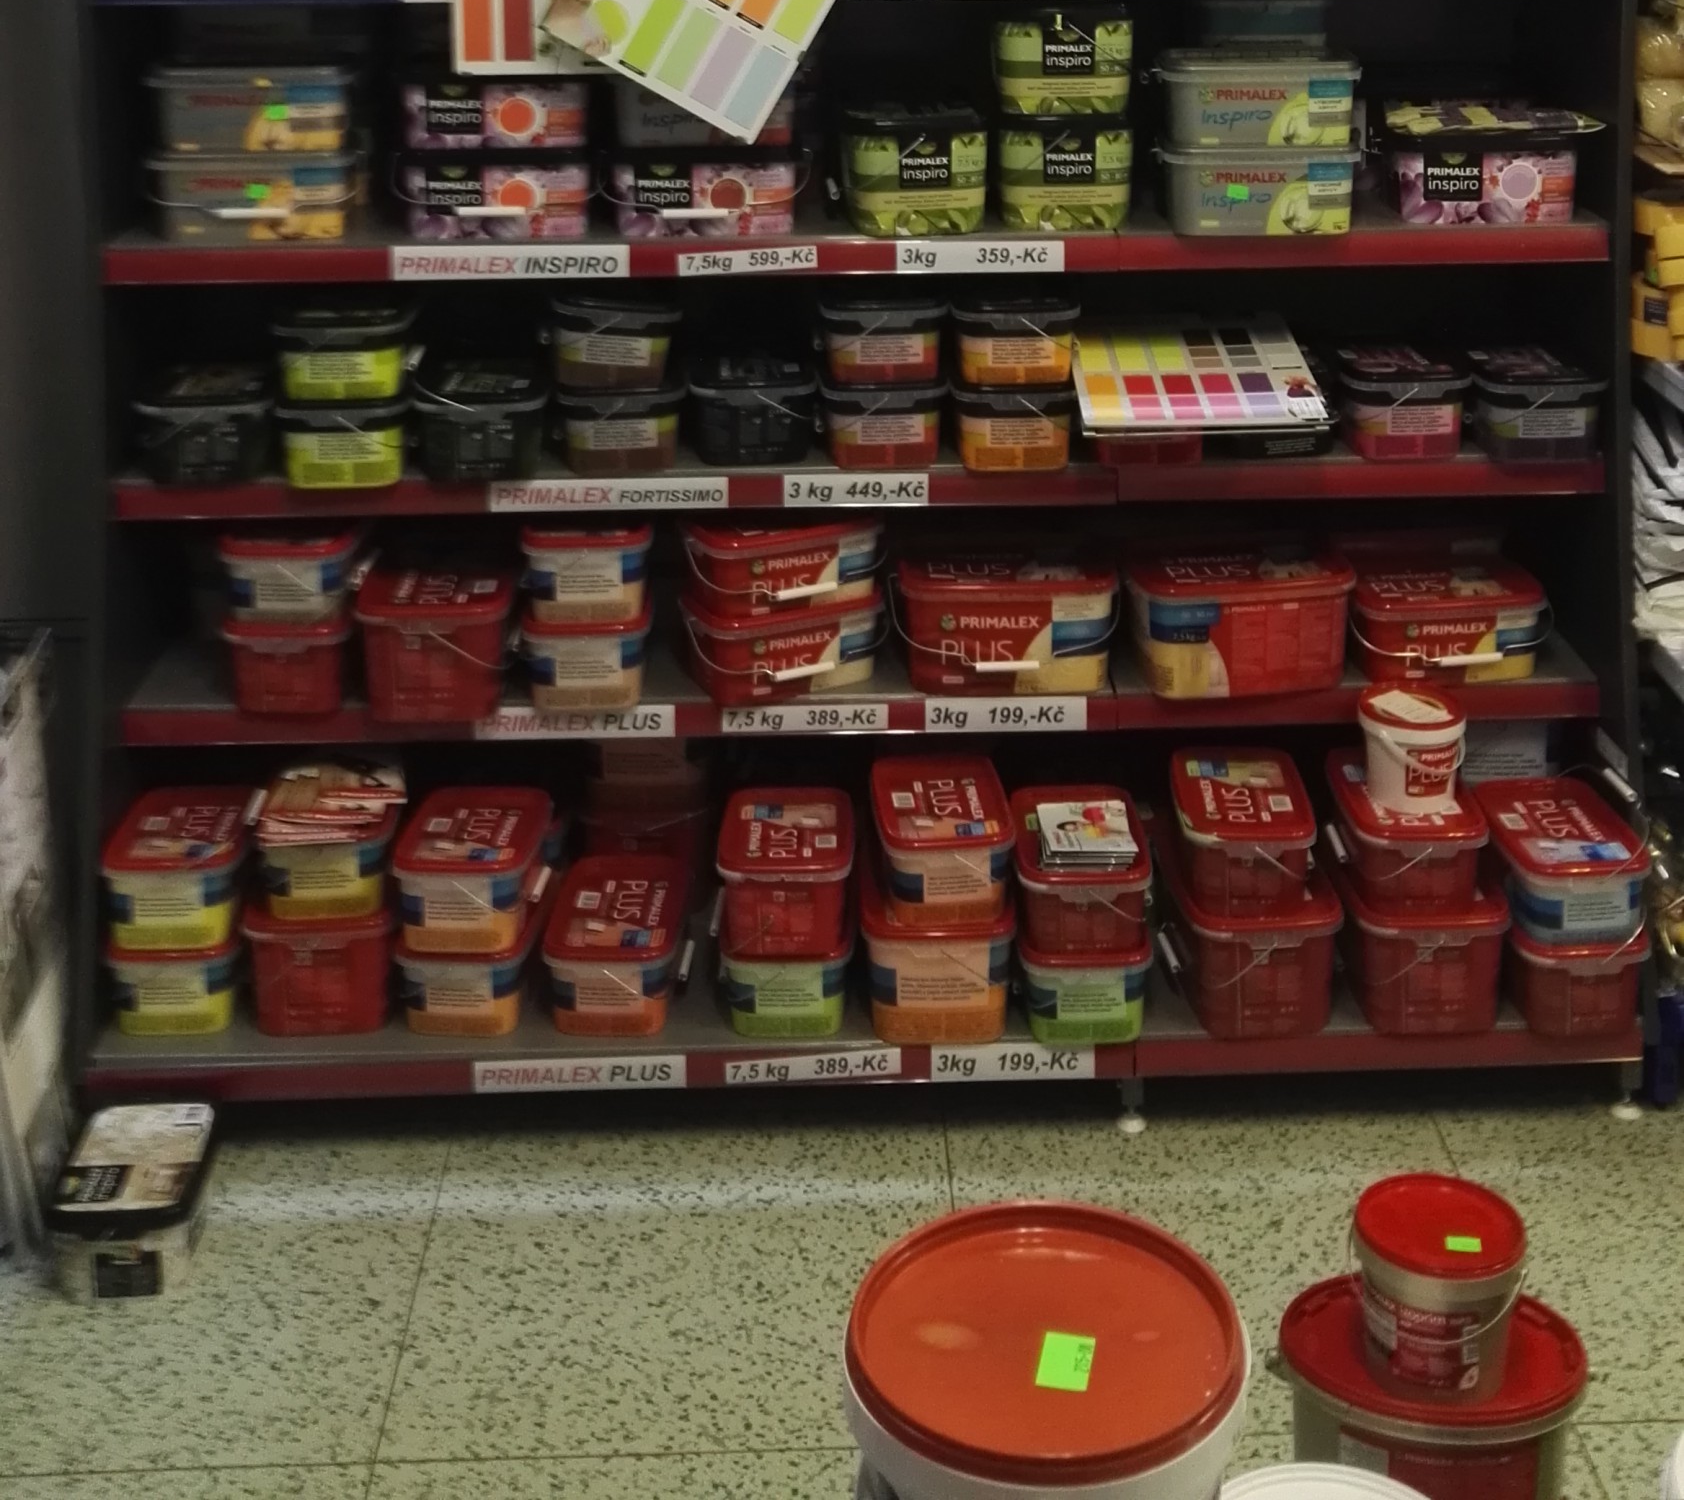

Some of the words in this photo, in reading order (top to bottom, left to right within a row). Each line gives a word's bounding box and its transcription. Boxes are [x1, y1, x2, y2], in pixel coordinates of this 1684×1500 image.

[1045, 44, 1093, 53] PRIMALEX
[1046, 54, 1092, 68] inspiro
[1216, 88, 1288, 101] PRIMALEX
[1201, 108, 1273, 131] Inspiro
[902, 157, 949, 166] PRIMALEX
[1046, 153, 1093, 162] PRIMALEX
[902, 167, 949, 182] inspiro
[1046, 162, 1093, 178] inspiro
[1216, 172, 1287, 184] PRIMALEX
[1427, 167, 1480, 177] PRIMALEX
[1428, 178, 1480, 193] inspiro
[638, 190, 690, 205] inspiro
[400, 257, 517, 274] PRIMALEX
[525, 257, 618, 273] INSPIRO
[686, 255, 733, 272] 7,5kg
[748, 248, 815, 267] 599,-Kč
[902, 248, 937, 269] 3kg
[976, 246, 1049, 265] 359,-Kč
[498, 487, 613, 505] PRIMALEX
[619, 489, 724, 504] FORTISSIMO
[789, 482, 801, 499] 3
[807, 481, 833, 501] kg
[846, 481, 925, 500] 449,-Kč
[769, 551, 832, 571] PRIMALEX
[1165, 564, 1250, 578] PLUS
[960, 616, 1039, 629] PRIMALEX
[1422, 622, 1487, 636] PRIMALEX
[770, 630, 832, 651] PRIMALEX
[481, 714, 596, 733] PRIMALEX
[604, 713, 662, 732] PLUS
[727, 711, 755, 729] 7,5
[759, 711, 784, 730] kg
[806, 708, 878, 727] 389,-Kč
[930, 707, 968, 728] 3kg
[988, 705, 1066, 725] 199,-Kč
[1222, 786, 1257, 823] PLUS
[612, 879, 649, 921] PLUS
[730, 1063, 759, 1083] 7,5
[764, 1062, 790, 1083] kg
[814, 1054, 889, 1077] 389,-Kč
[937, 1053, 976, 1075] 3kg
[997, 1051, 1080, 1073] 199,-Kč
[480, 1065, 602, 1087] PRIMALEX
[610, 1063, 672, 1083] PLUS
